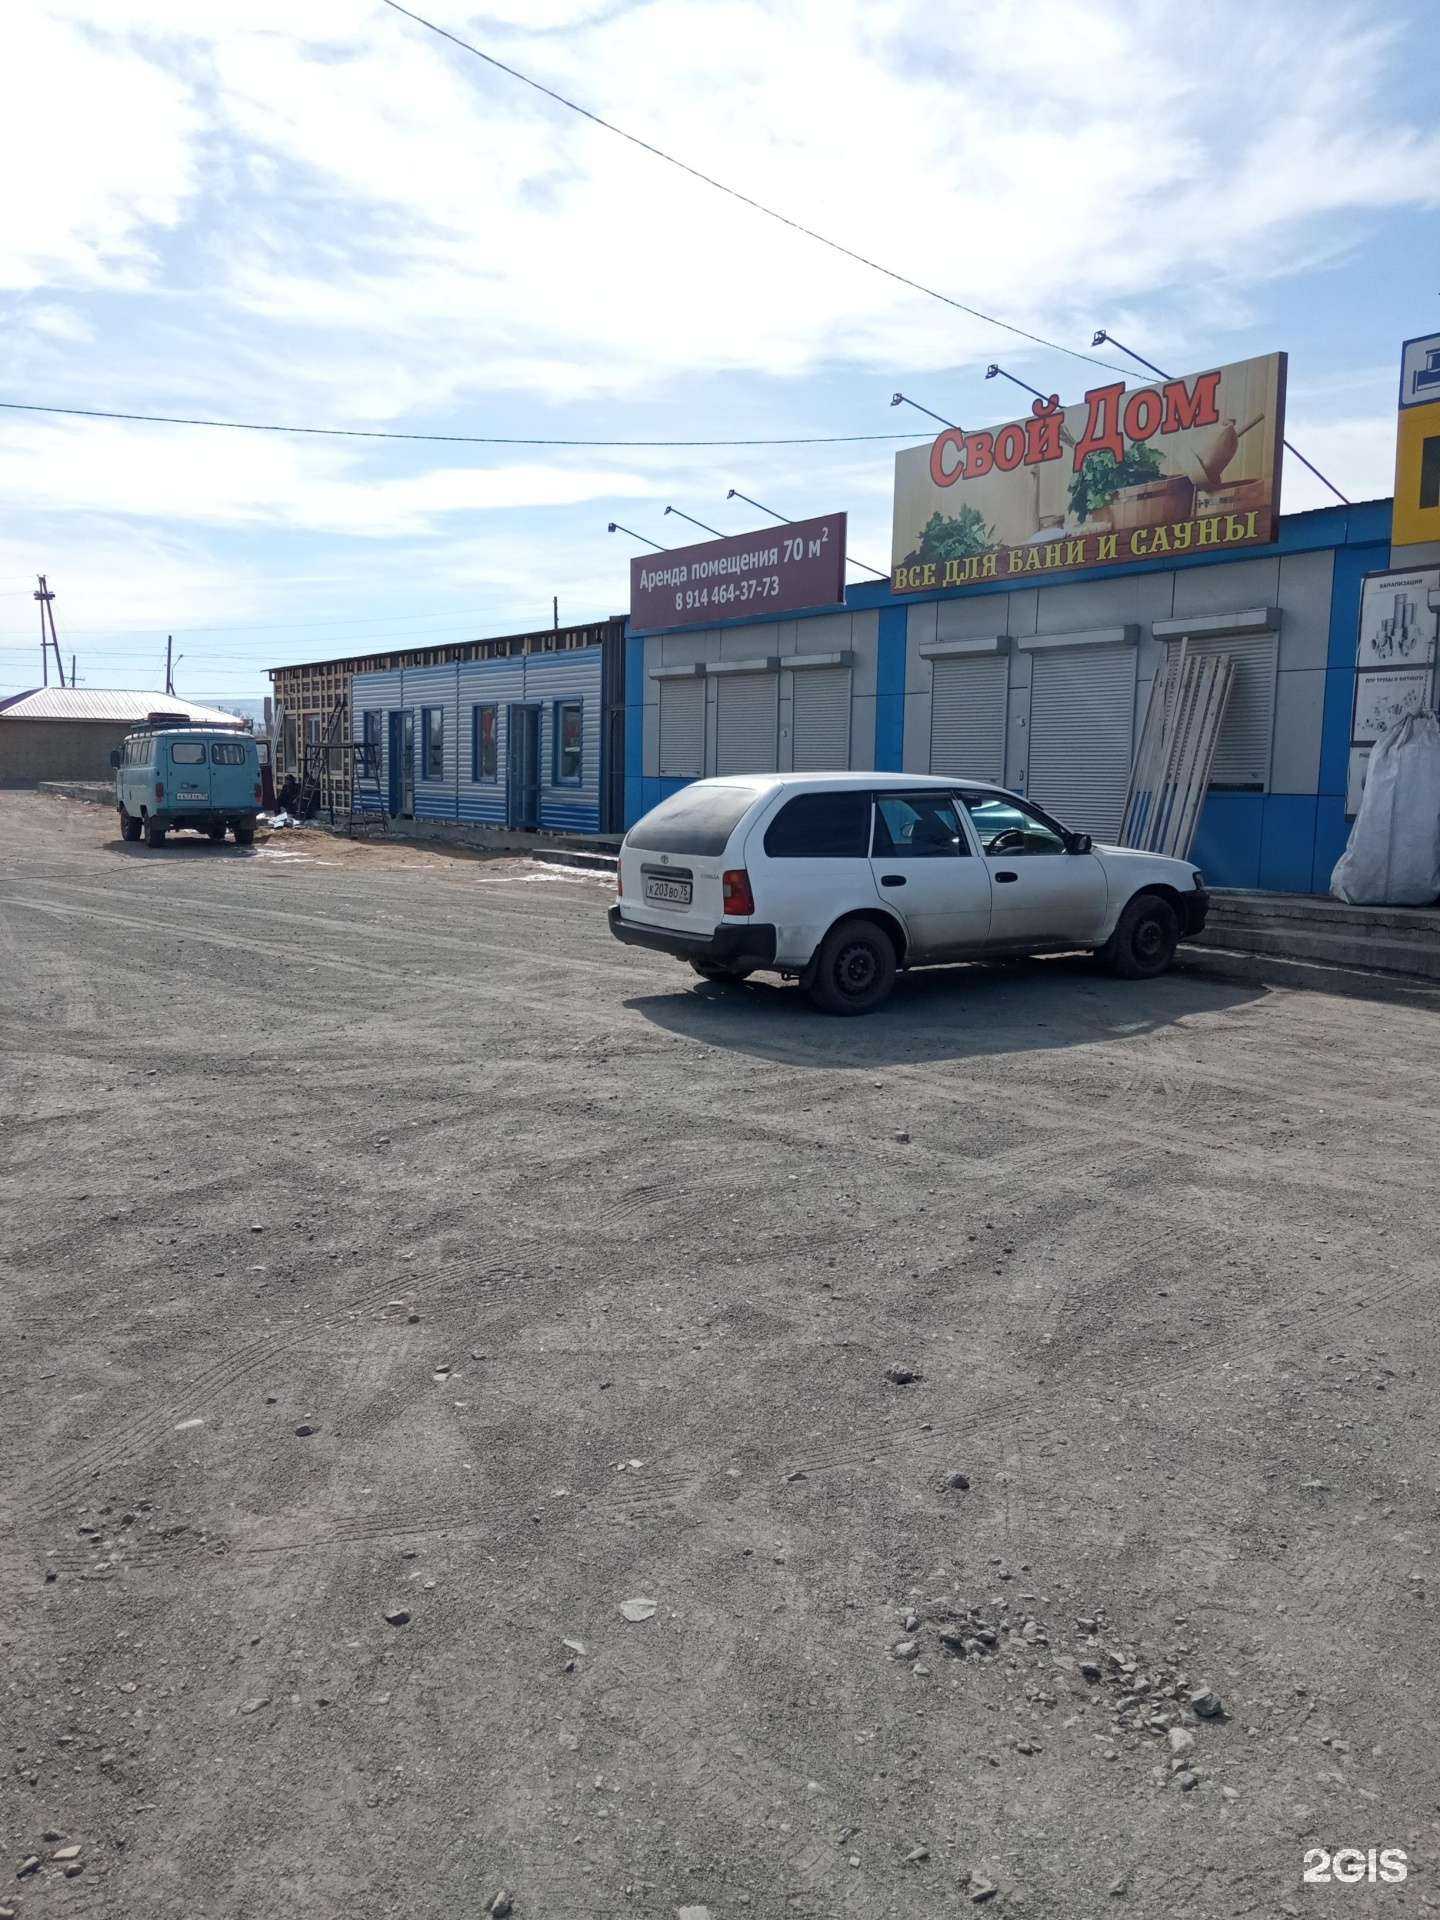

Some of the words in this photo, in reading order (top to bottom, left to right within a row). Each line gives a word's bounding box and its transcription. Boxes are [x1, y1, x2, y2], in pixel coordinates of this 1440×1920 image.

[929, 394, 1065, 488] Свой
[1073, 371, 1221, 473] Дом
[639, 564, 687, 592] Аренда
[691, 547, 778, 580] помещения
[783, 538, 803, 563] 70
[894, 563, 937, 589] ВСЕ
[943, 553, 999, 587] ДЛЯ
[1007, 539, 1086, 574] БАНИ
[1096, 533, 1119, 561] И
[1130, 511, 1259, 556] САУНЫ
[675, 593, 682, 610] 8
[686, 588, 708, 609] 914
[711, 576, 780, 604] 464-37-73
